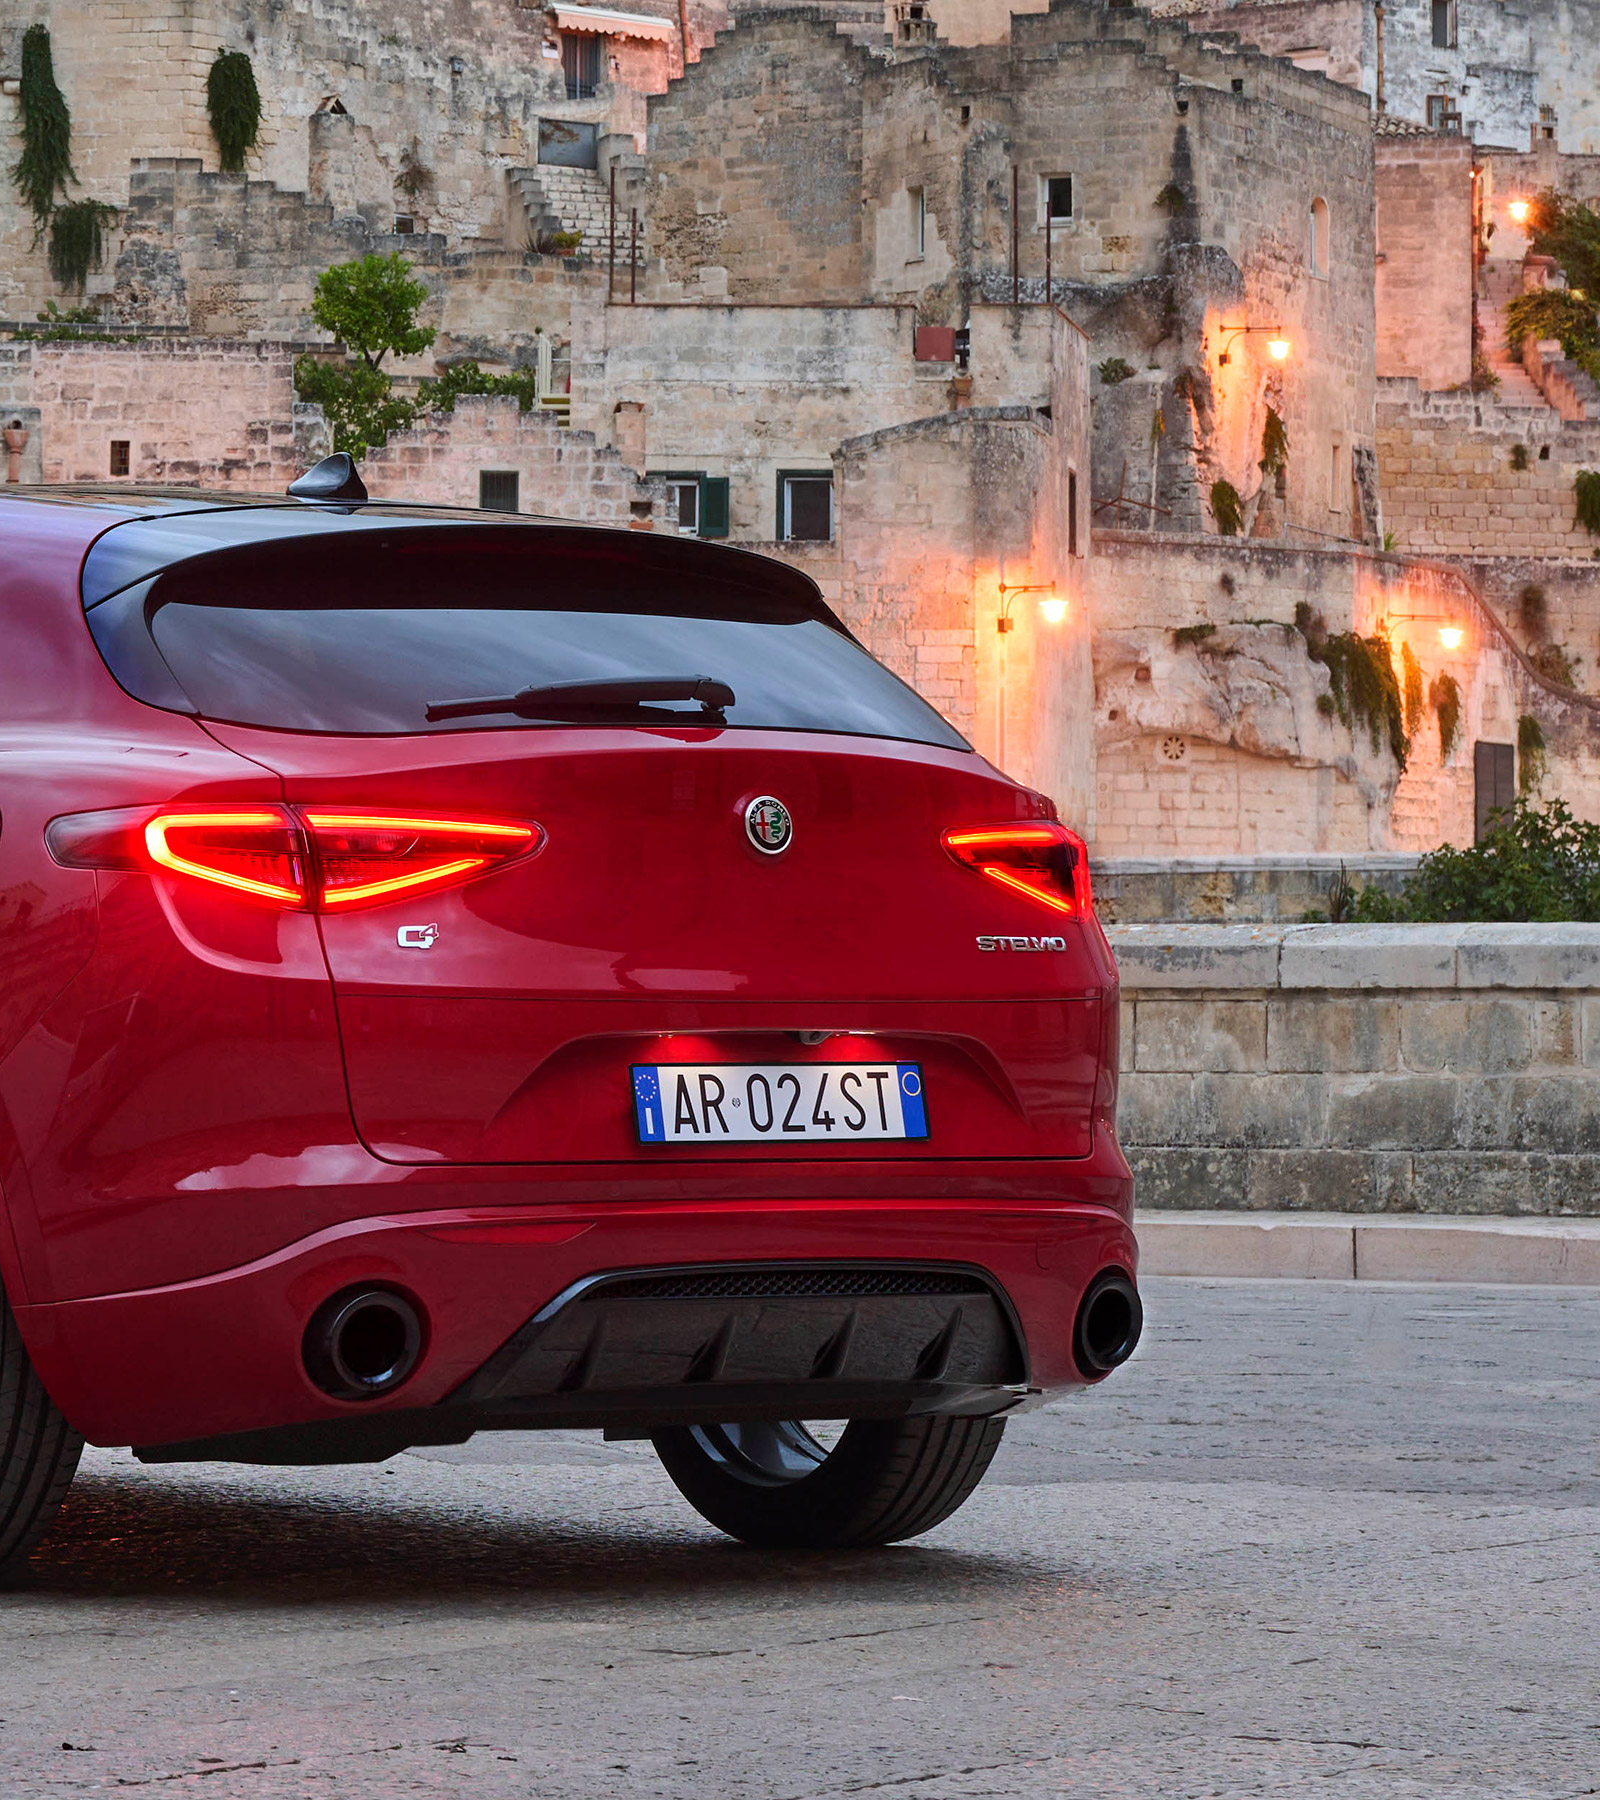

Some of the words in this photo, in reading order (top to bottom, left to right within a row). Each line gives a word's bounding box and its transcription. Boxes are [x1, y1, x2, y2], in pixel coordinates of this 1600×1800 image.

[397, 923, 440, 950] Q4
[976, 935, 1067, 952] STELVIO
[674, 1073, 730, 1134] AR
[746, 1072, 890, 1133] 024ST
